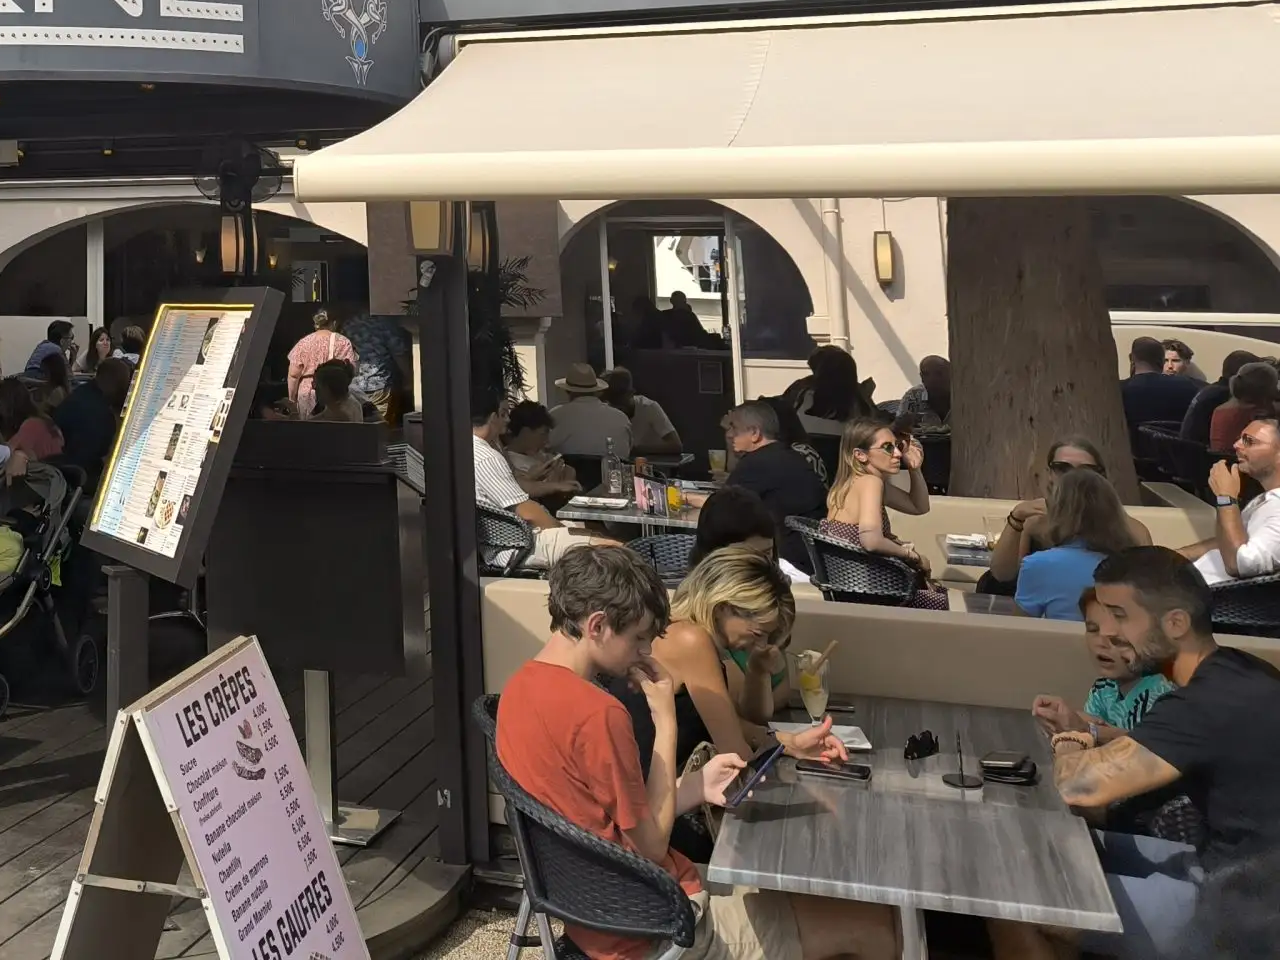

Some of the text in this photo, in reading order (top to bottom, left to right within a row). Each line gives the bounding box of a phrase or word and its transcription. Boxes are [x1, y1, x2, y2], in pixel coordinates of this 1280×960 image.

[175, 666, 258, 748] LES CRÊPES
[180, 757, 197, 776] Sucre
[186, 767, 212, 794] Chocolat
[193, 786, 219, 813] Confiture
[204, 822, 227, 847] Banane
[225, 801, 248, 829] chocolat
[211, 841, 232, 865] Nutella
[218, 856, 243, 884] Chantilly
[224, 880, 244, 904] Crème
[241, 872, 250, 887] de
[248, 853, 269, 880] marrons
[231, 897, 252, 923] Banane
[251, 878, 269, 902] nutella
[238, 917, 254, 942] Grand
[252, 898, 273, 926] Marnier
[276, 870, 333, 956] GAUFRES
